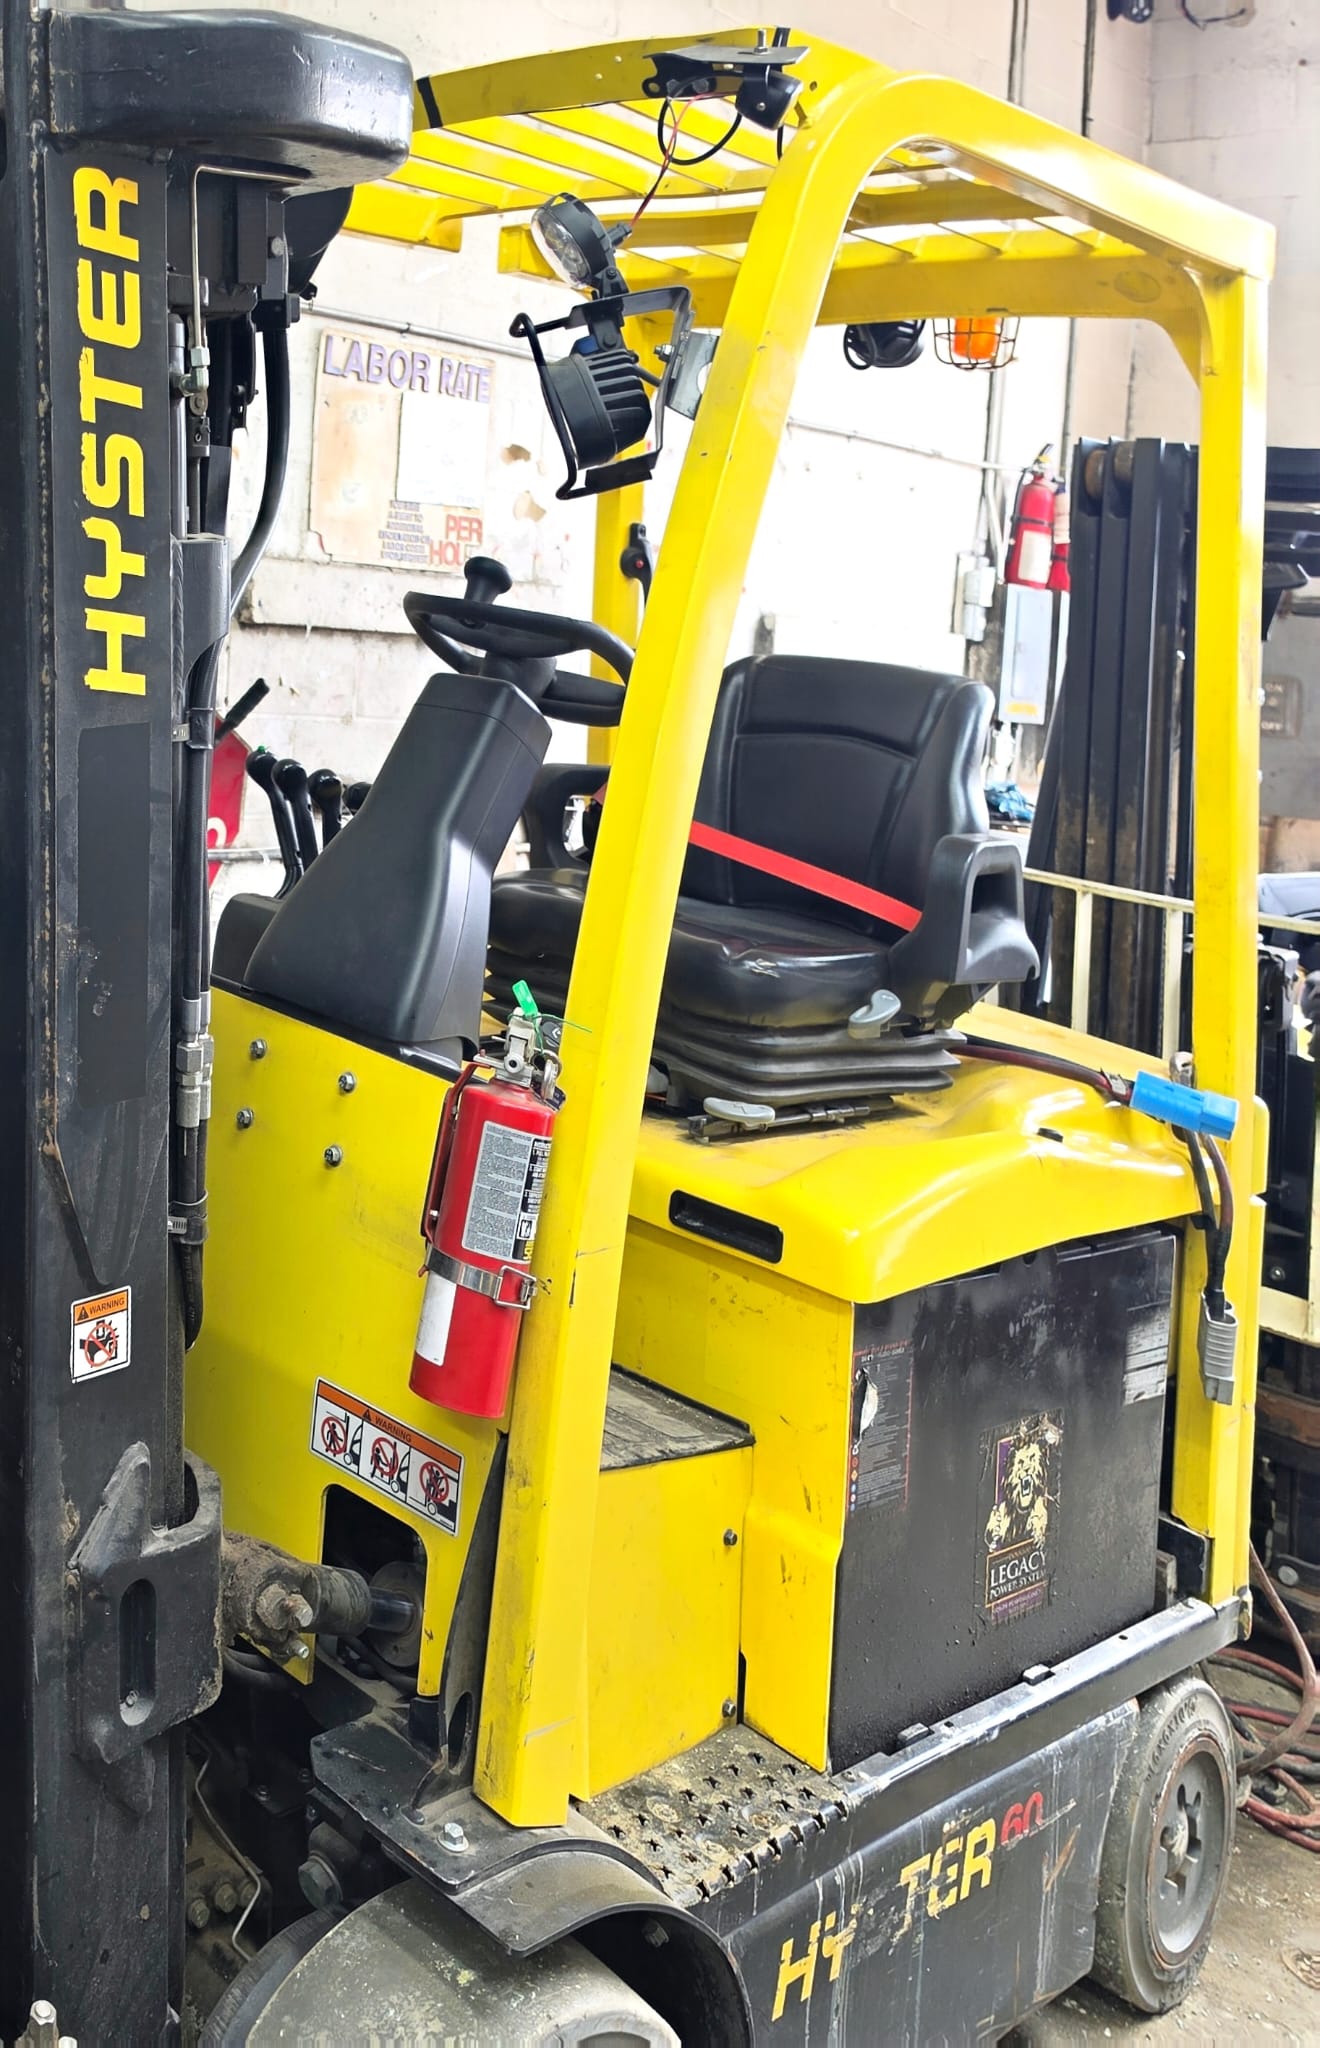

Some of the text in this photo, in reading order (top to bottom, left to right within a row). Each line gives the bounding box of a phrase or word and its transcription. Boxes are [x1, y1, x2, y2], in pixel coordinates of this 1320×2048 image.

[323, 334, 491, 404] LABOR RATE
[73, 167, 146, 696] HYSTER
[445, 513, 483, 545] PER
[429, 539, 466, 567] HOU
[89, 1297, 125, 1315] WARNING
[375, 1416, 412, 1443] WARNING
[990, 1550, 1047, 1588] LEGACY
[990, 1580, 1018, 1600] POWER
[771, 1818, 996, 2022] HYTER
